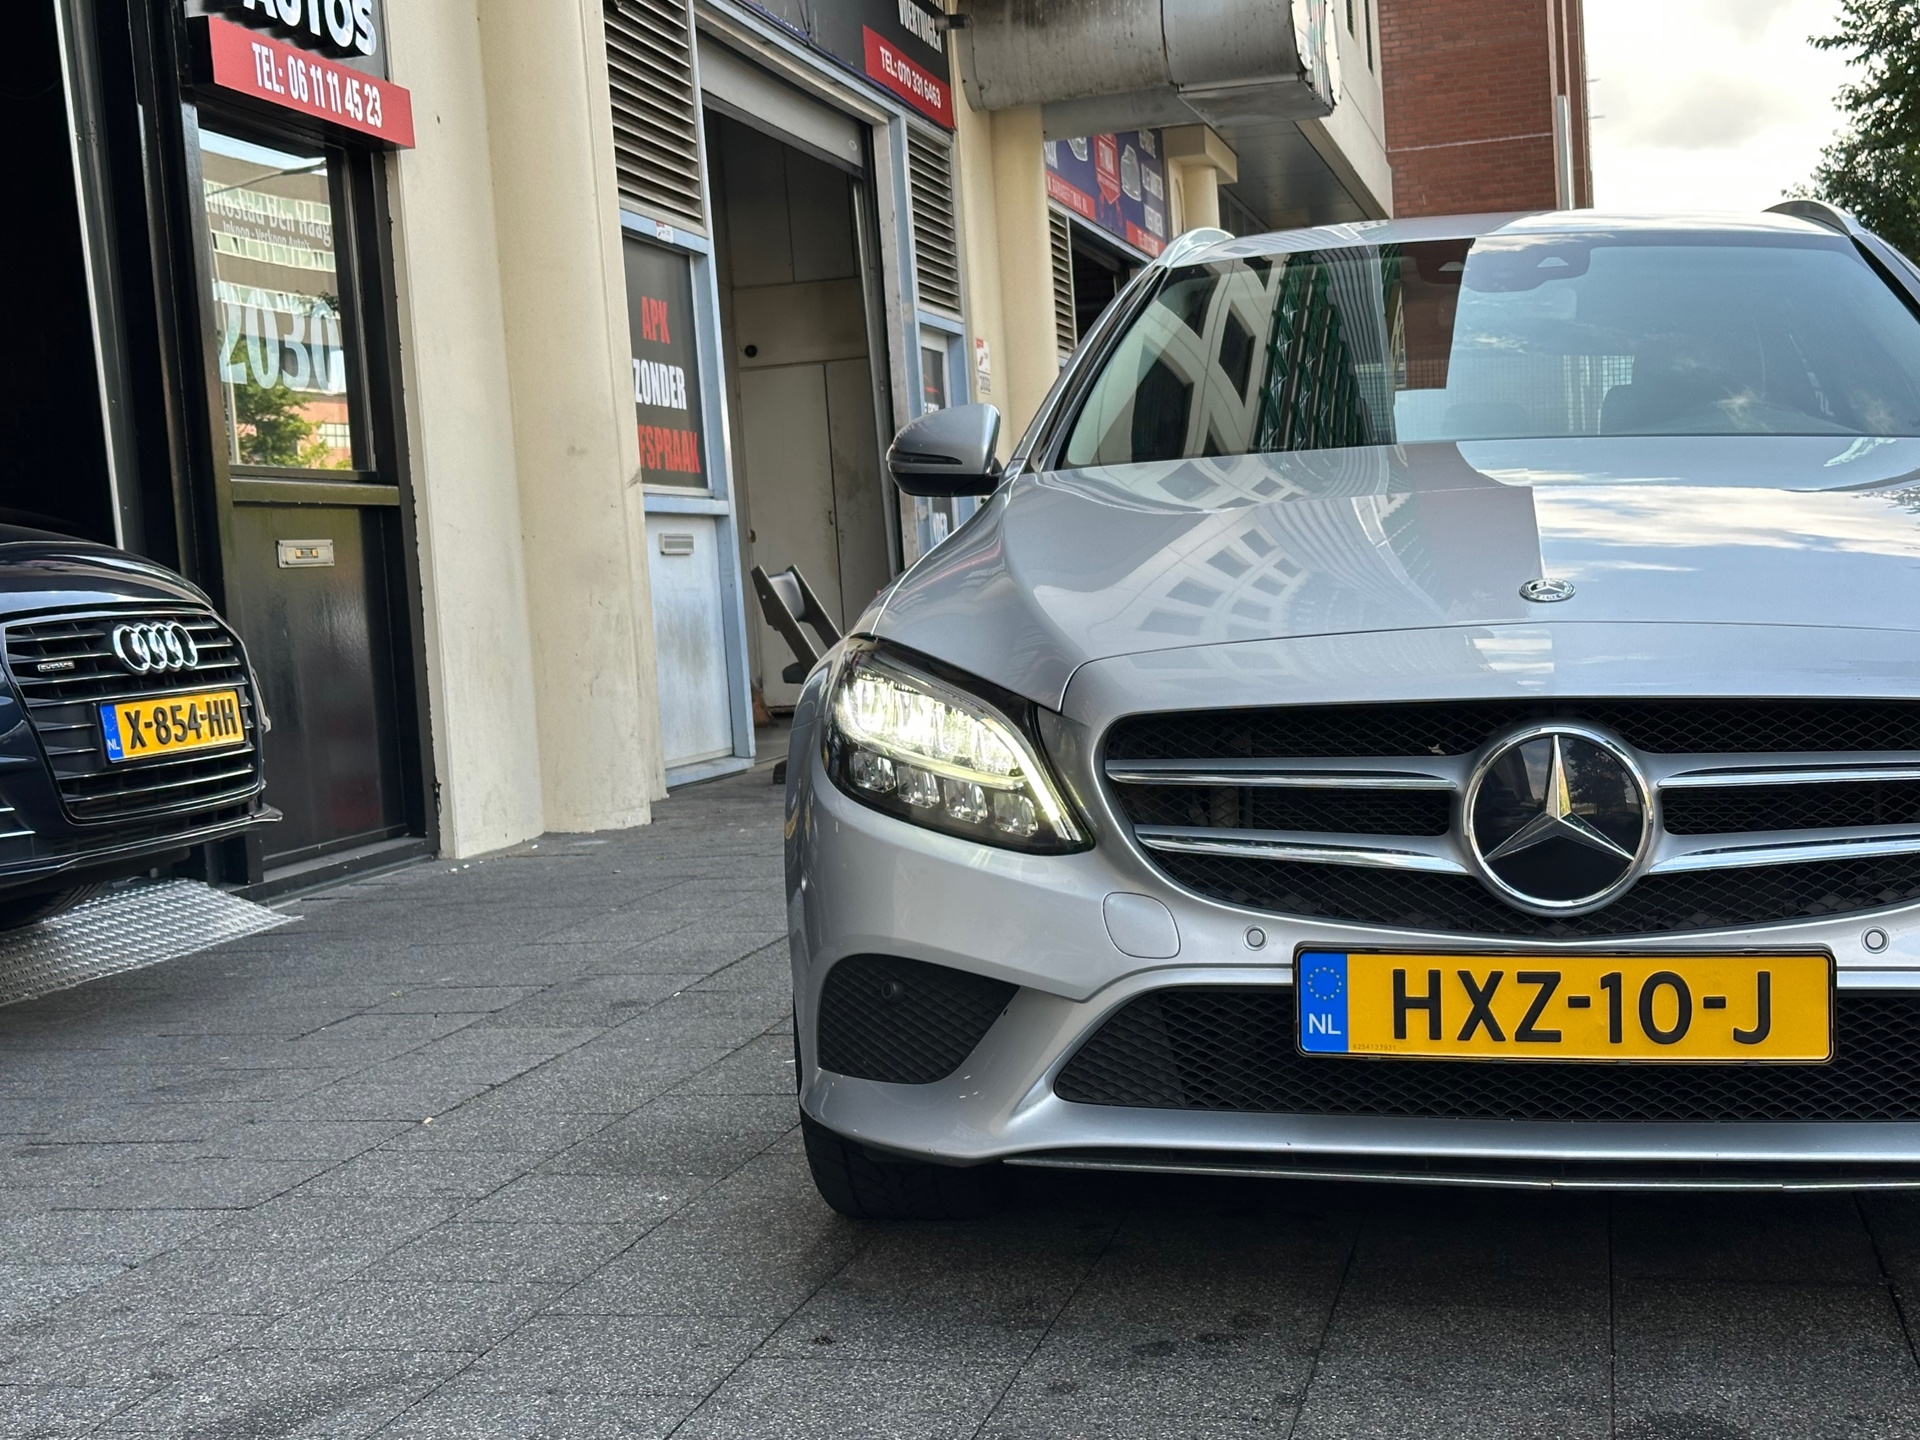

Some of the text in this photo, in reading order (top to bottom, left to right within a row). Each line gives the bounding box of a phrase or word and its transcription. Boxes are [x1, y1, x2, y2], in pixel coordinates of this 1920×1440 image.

[252, 42, 382, 128] TEL: 06 11 11 45 23
[879, 45, 898, 78] TEL:
[897, 59, 912, 89] 070
[268, 200, 295, 232] Den
[298, 207, 332, 247] Haag
[219, 281, 341, 396] 2030
[641, 296, 670, 344] APK
[632, 358, 687, 410] ZONDER
[638, 424, 701, 473] FSPRAAK
[107, 739, 121, 751] NL
[124, 698, 238, 750] X-854-HH
[1308, 1013, 1341, 1035] NL
[1392, 968, 1772, 1045] HXZ-10-J
